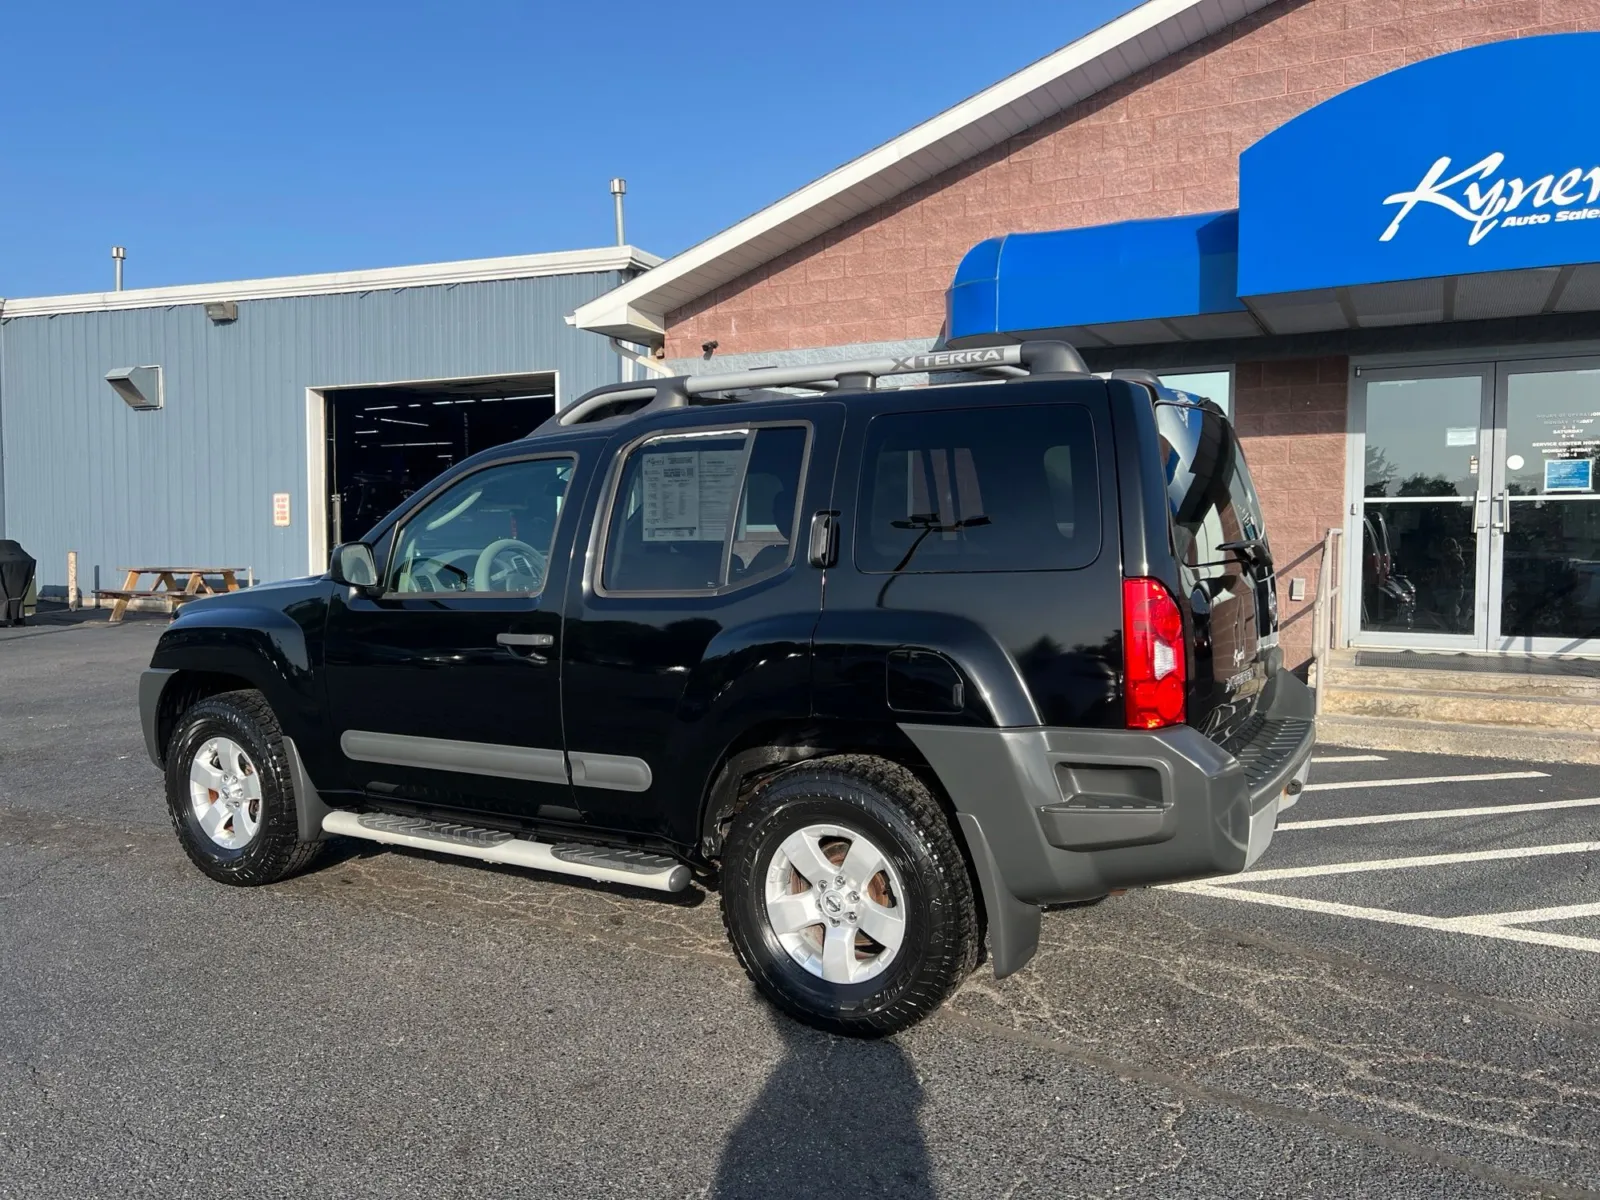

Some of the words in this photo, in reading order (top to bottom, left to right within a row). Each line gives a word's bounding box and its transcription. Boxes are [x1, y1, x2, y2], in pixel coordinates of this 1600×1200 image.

[1501, 213, 1551, 228] Auto
[1554, 208, 1600, 222] Sale
[890, 349, 1000, 371] XTERRA
